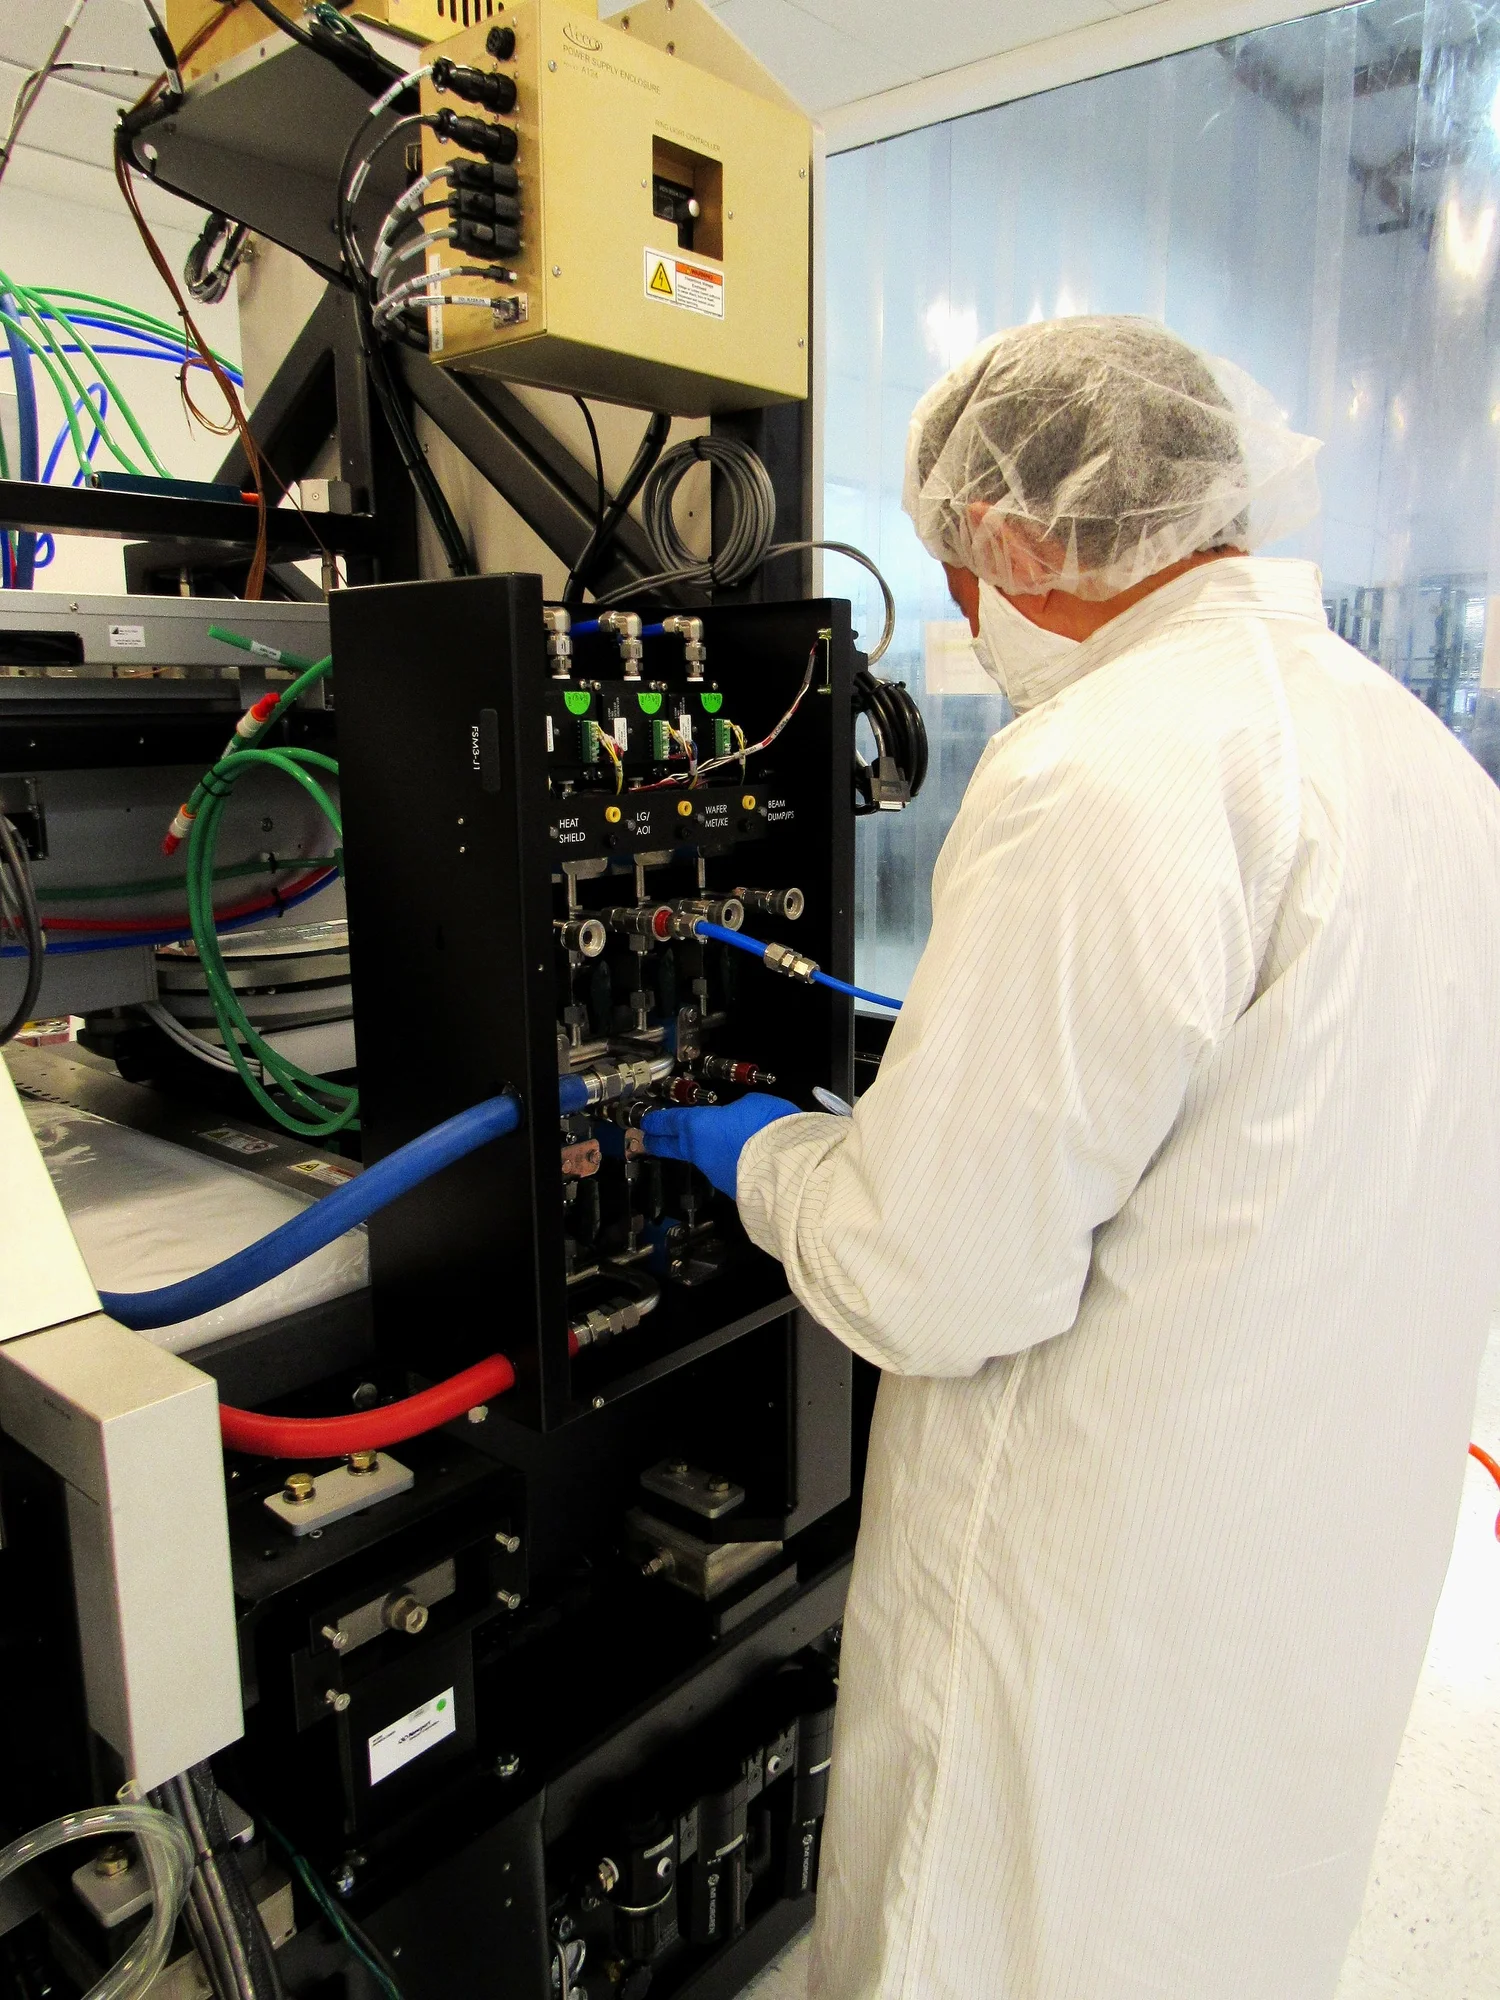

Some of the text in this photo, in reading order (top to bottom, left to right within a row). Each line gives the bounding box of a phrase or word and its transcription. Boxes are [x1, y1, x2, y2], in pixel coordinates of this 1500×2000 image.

[563, 44, 591, 63] POWER
[592, 58, 619, 75] SUPPLY
[620, 70, 661, 94] ENCLOSURE
[471, 725, 480, 770] FSM3-J1
[705, 804, 728, 815] WAFER
[767, 799, 786, 809] BEAM
[636, 811, 650, 822] LG/
[767, 810, 795, 822] DUMP/PS
[559, 818, 579, 829] HEAT
[704, 817, 729, 828] MET/KE
[636, 825, 651, 836] AOI
[559, 832, 586, 844] SHIELD
